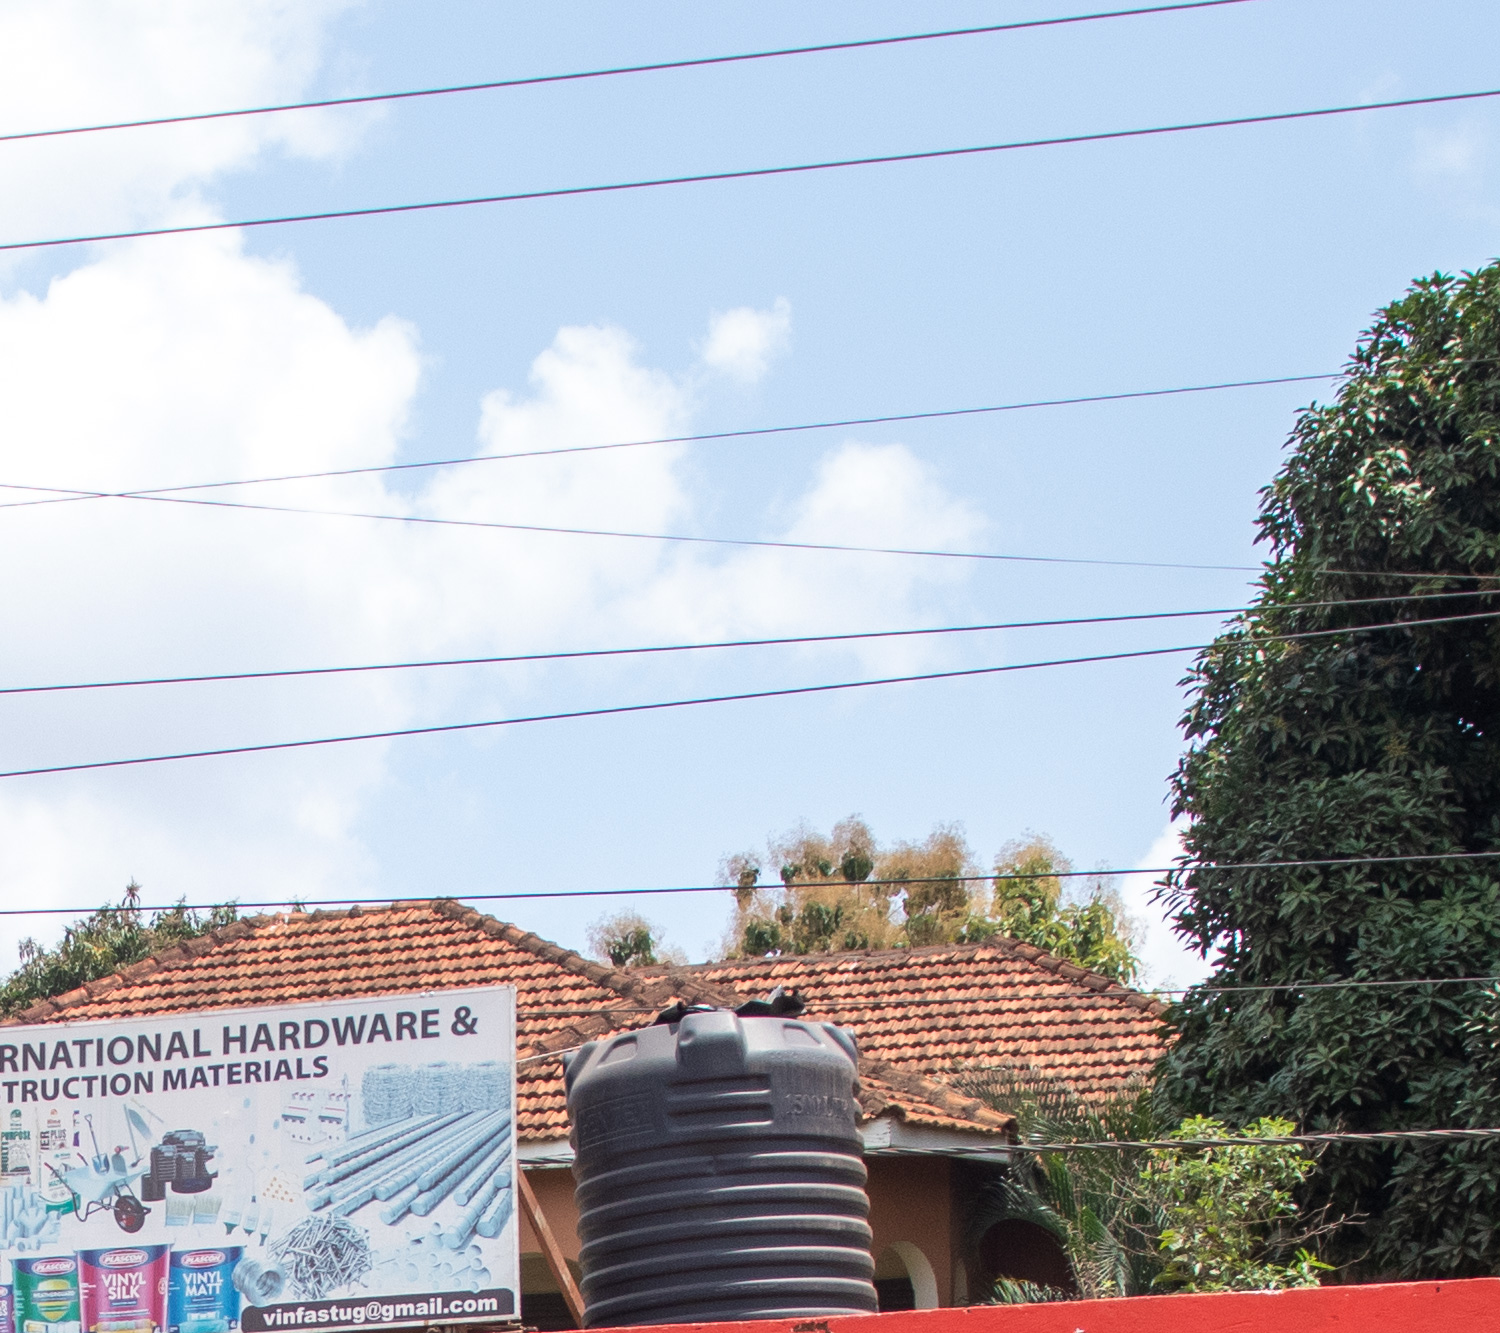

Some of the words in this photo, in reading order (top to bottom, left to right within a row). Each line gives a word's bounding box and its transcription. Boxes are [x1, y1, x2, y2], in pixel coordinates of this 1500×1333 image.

[223, 1008, 440, 1055] HARDWARE
[451, 1006, 478, 1035] &
[163, 1055, 329, 1092] MATERIALS
[50, 1129, 67, 1139] PLUS
[105, 1254, 144, 1263] PLASCON
[185, 1255, 221, 1263] PLASCON
[101, 1272, 146, 1288] VINYL
[182, 1271, 223, 1285] VINYL
[108, 1286, 140, 1300] SILK
[185, 1283, 222, 1296] MATT
[263, 1293, 498, 1328] vinfastug@gmail.com
